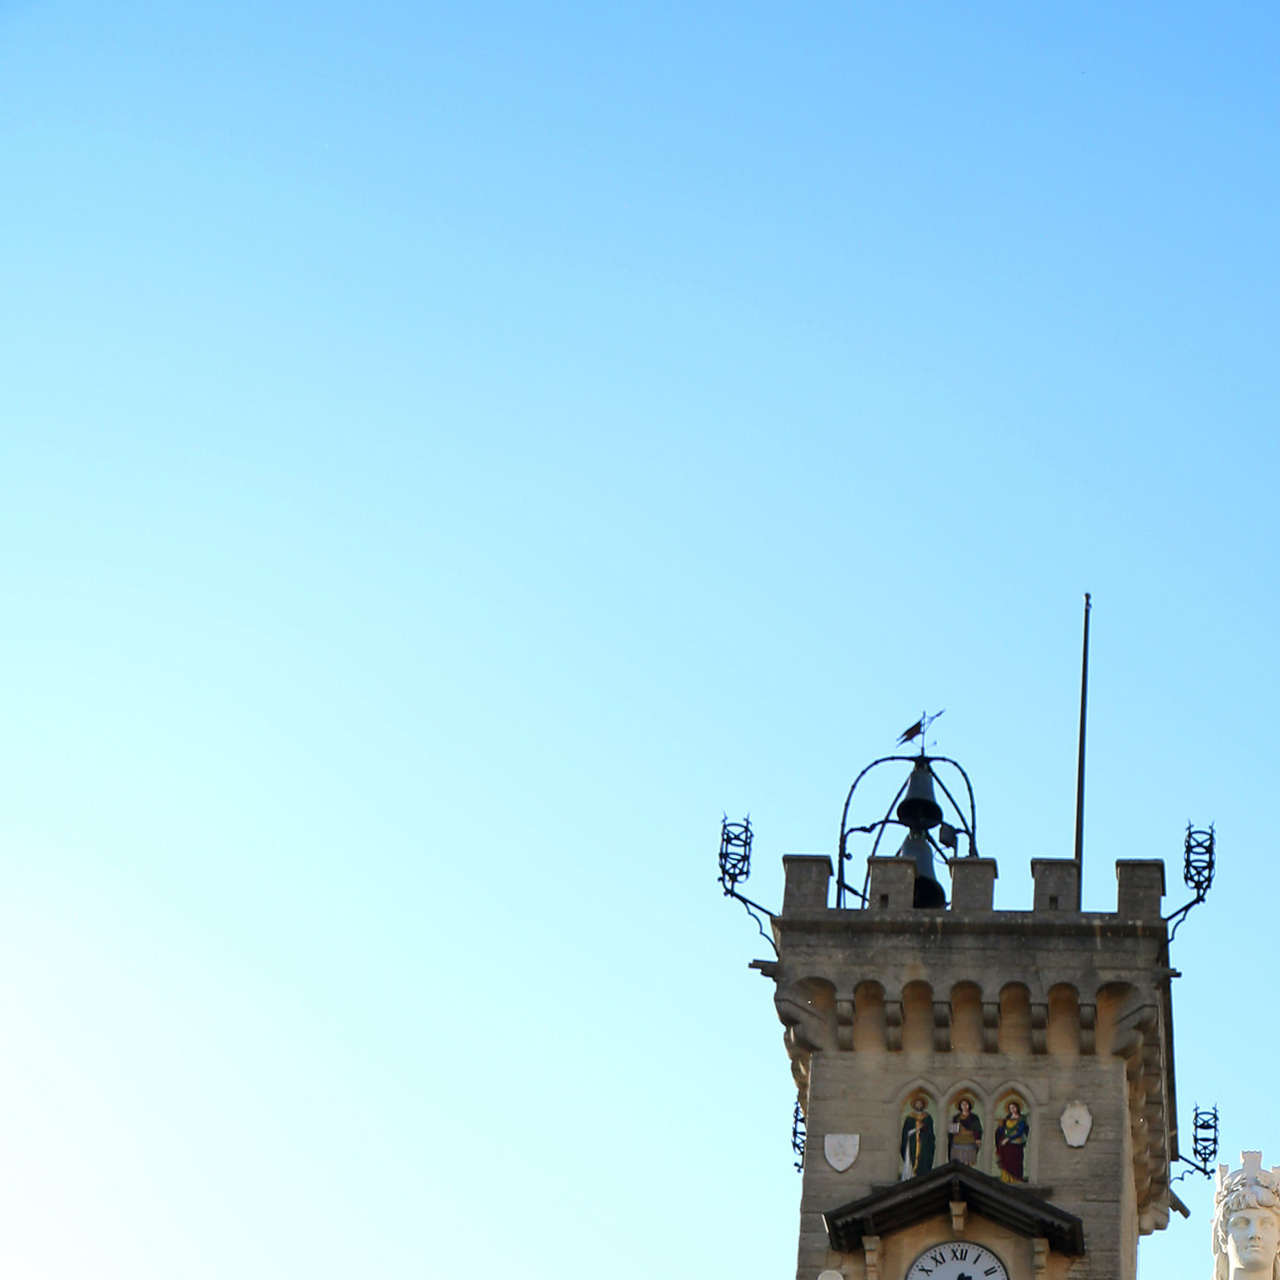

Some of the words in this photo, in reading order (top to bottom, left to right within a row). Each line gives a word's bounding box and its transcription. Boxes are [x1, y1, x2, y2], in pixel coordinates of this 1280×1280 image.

[931, 1252, 946, 1267] XI
[951, 1249, 968, 1261] XII
[973, 1254, 982, 1265] I
[919, 1265, 933, 1277] X
[984, 1266, 998, 1277] II
